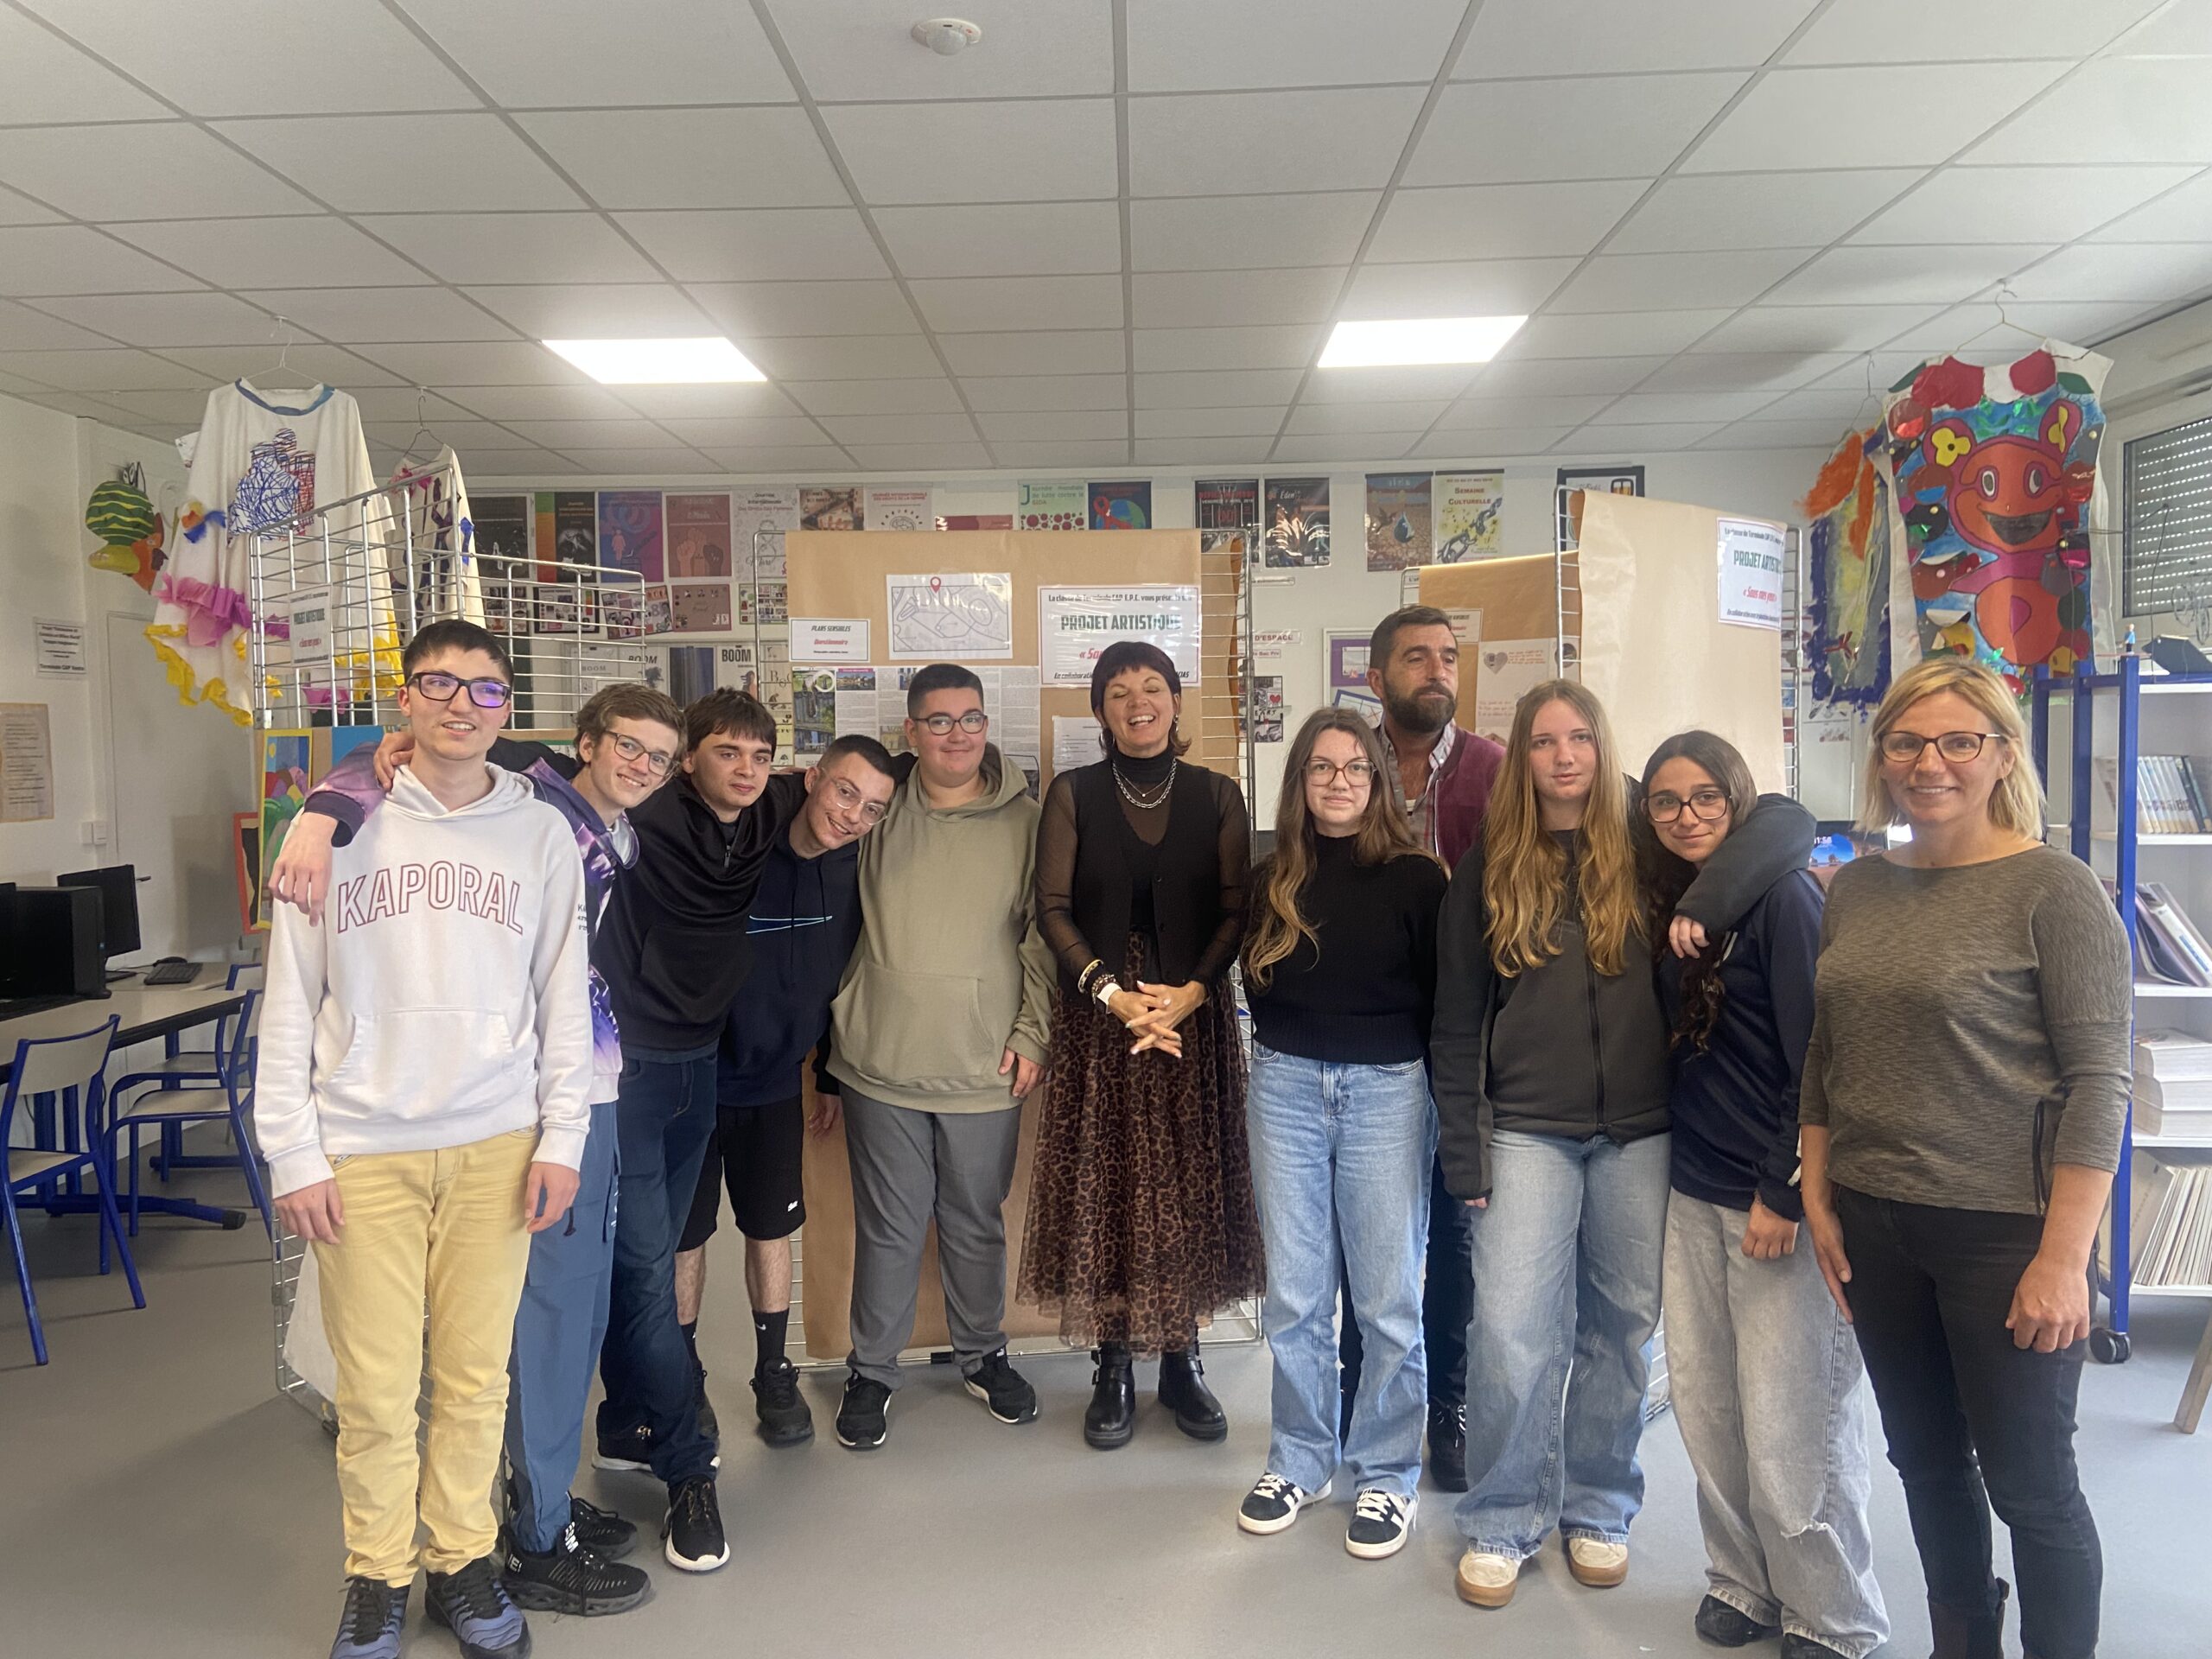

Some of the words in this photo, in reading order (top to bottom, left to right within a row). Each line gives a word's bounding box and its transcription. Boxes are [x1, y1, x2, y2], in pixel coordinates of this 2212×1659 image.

[1733, 550, 1761, 569] PROJET
[1061, 614, 1108, 631] PROJET
[721, 648, 752, 663] BOOM
[337, 861, 524, 936] KAPORAL
